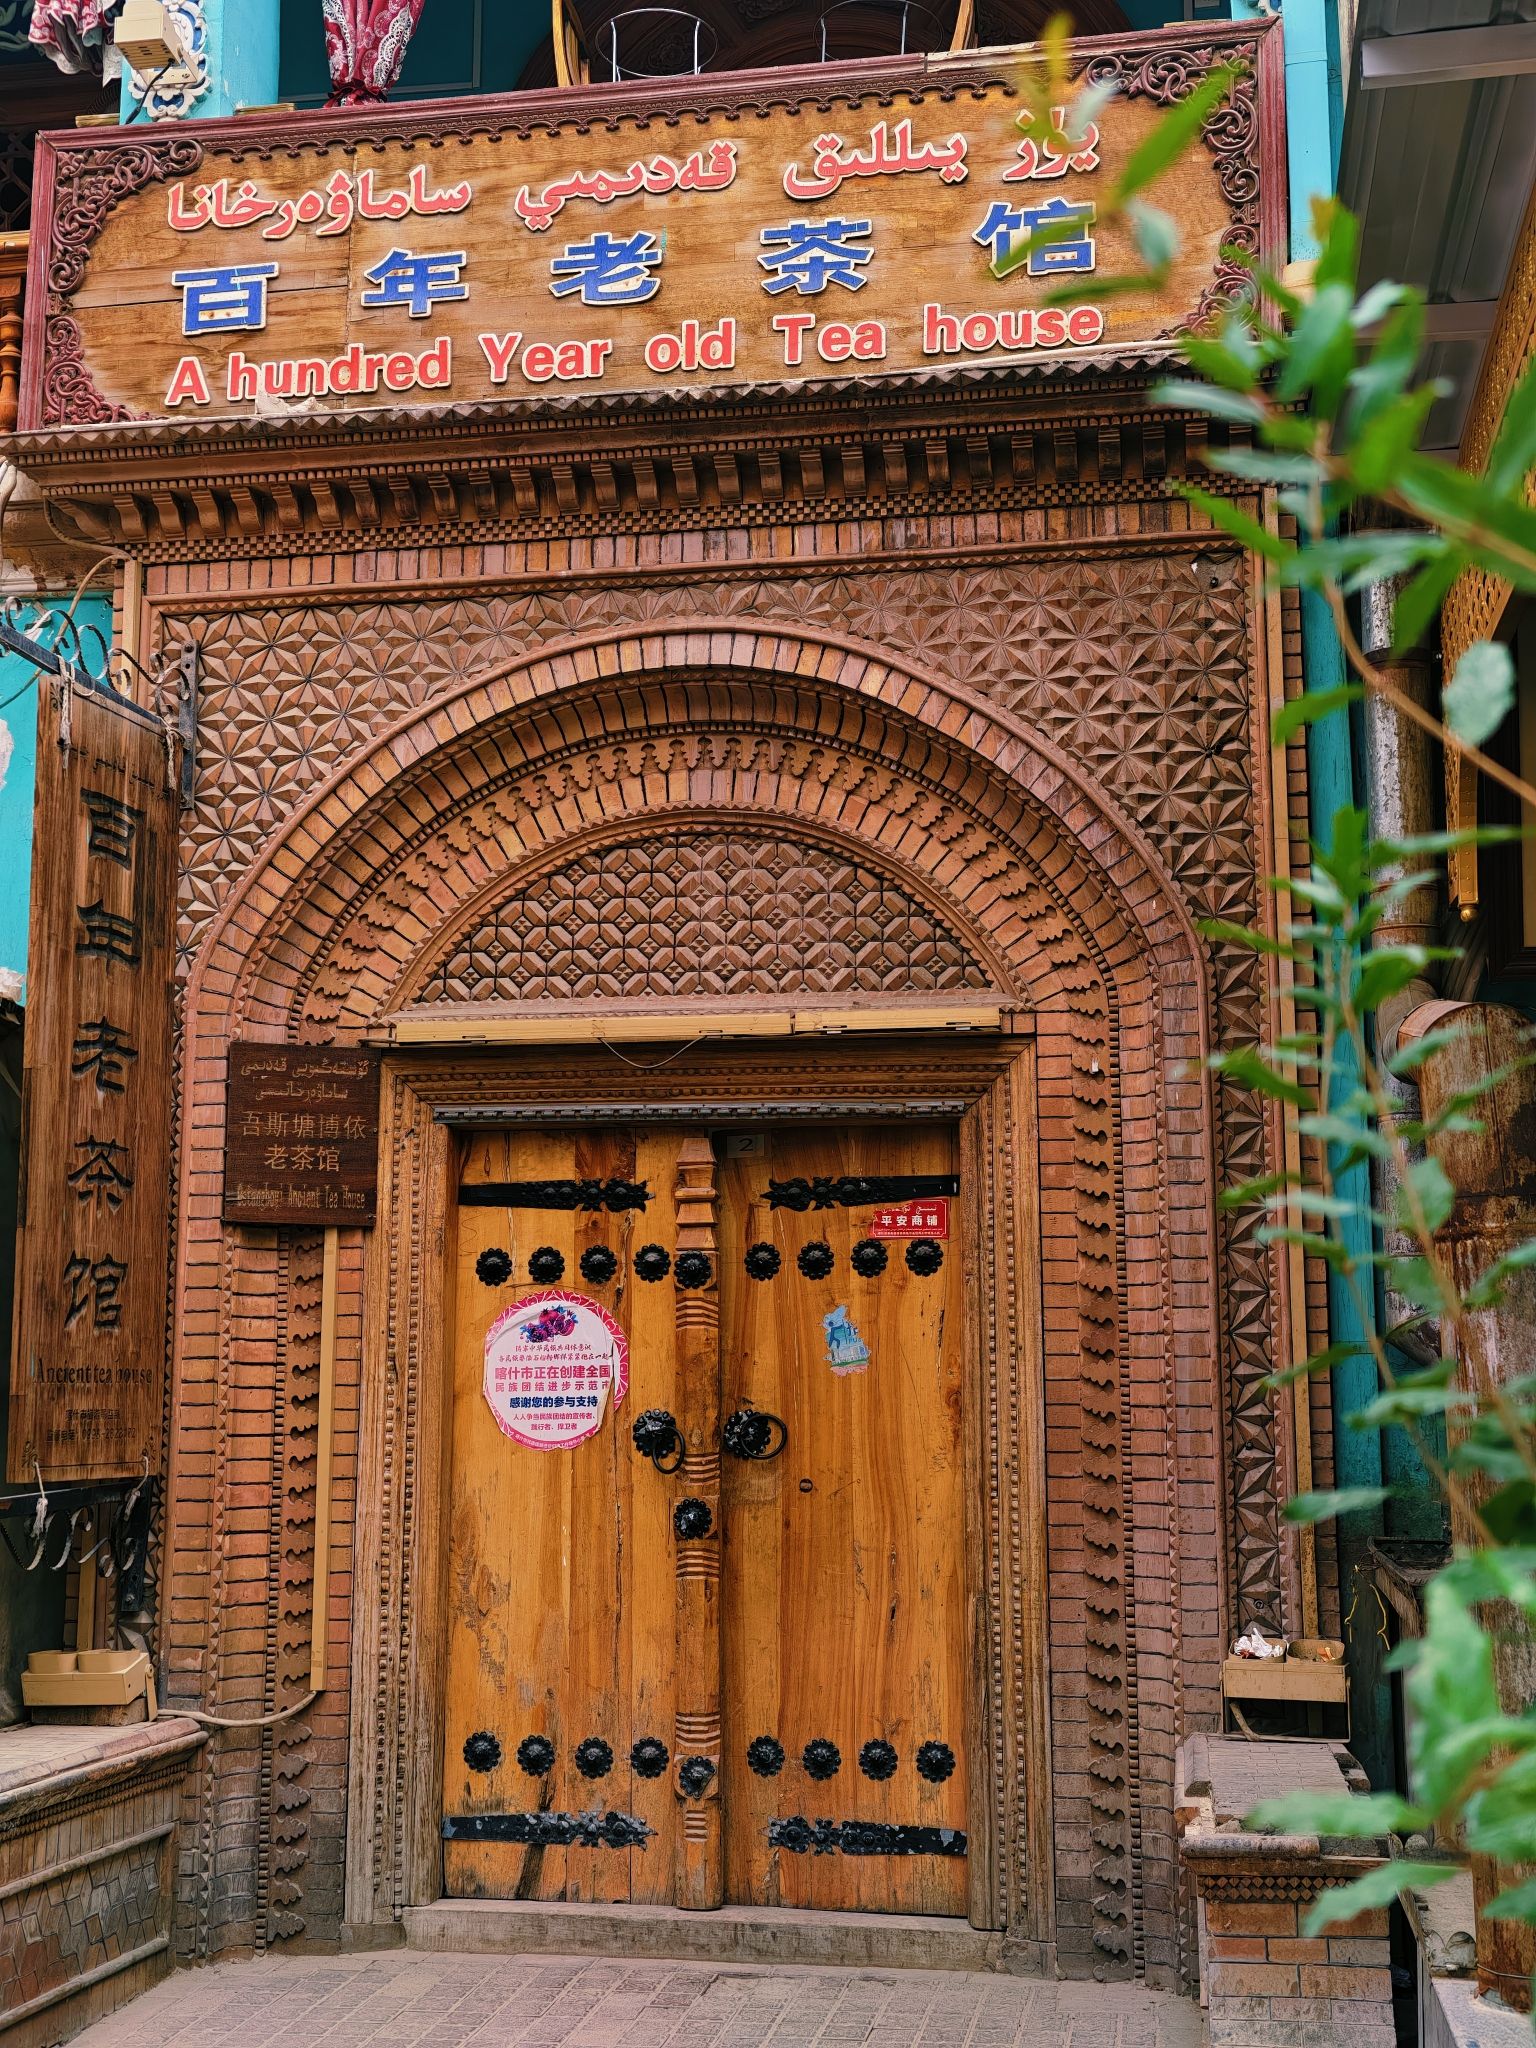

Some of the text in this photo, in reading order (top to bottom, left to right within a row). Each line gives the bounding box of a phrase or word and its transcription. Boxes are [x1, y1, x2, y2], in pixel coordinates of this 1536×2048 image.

[783, 119, 969, 199] يىللىق
[514, 139, 738, 231] قەدىمىي
[167, 164, 473, 240] ساماۋەرخانا
[172, 196, 1097, 336] 百年老茶馆
[165, 303, 1104, 406] A hundred Year old Tea house
[62, 787, 146, 1333] 百年老茶馆
[240, 1111, 367, 1139] 吾斯塘博依
[264, 1144, 340, 1172] 老茶馆
[737, 1137, 754, 1152] 2
[288, 1183, 321, 1209] Ancient
[324, 1184, 338, 1209] Tea
[342, 1185, 366, 1209] House
[881, 1215, 938, 1227] 平安商铺
[34, 1359, 153, 1384] Ancient tea house
[495, 1365, 611, 1380] 喀什市正在创建全国
[510, 1396, 598, 1408] 感谢您的参与支持
